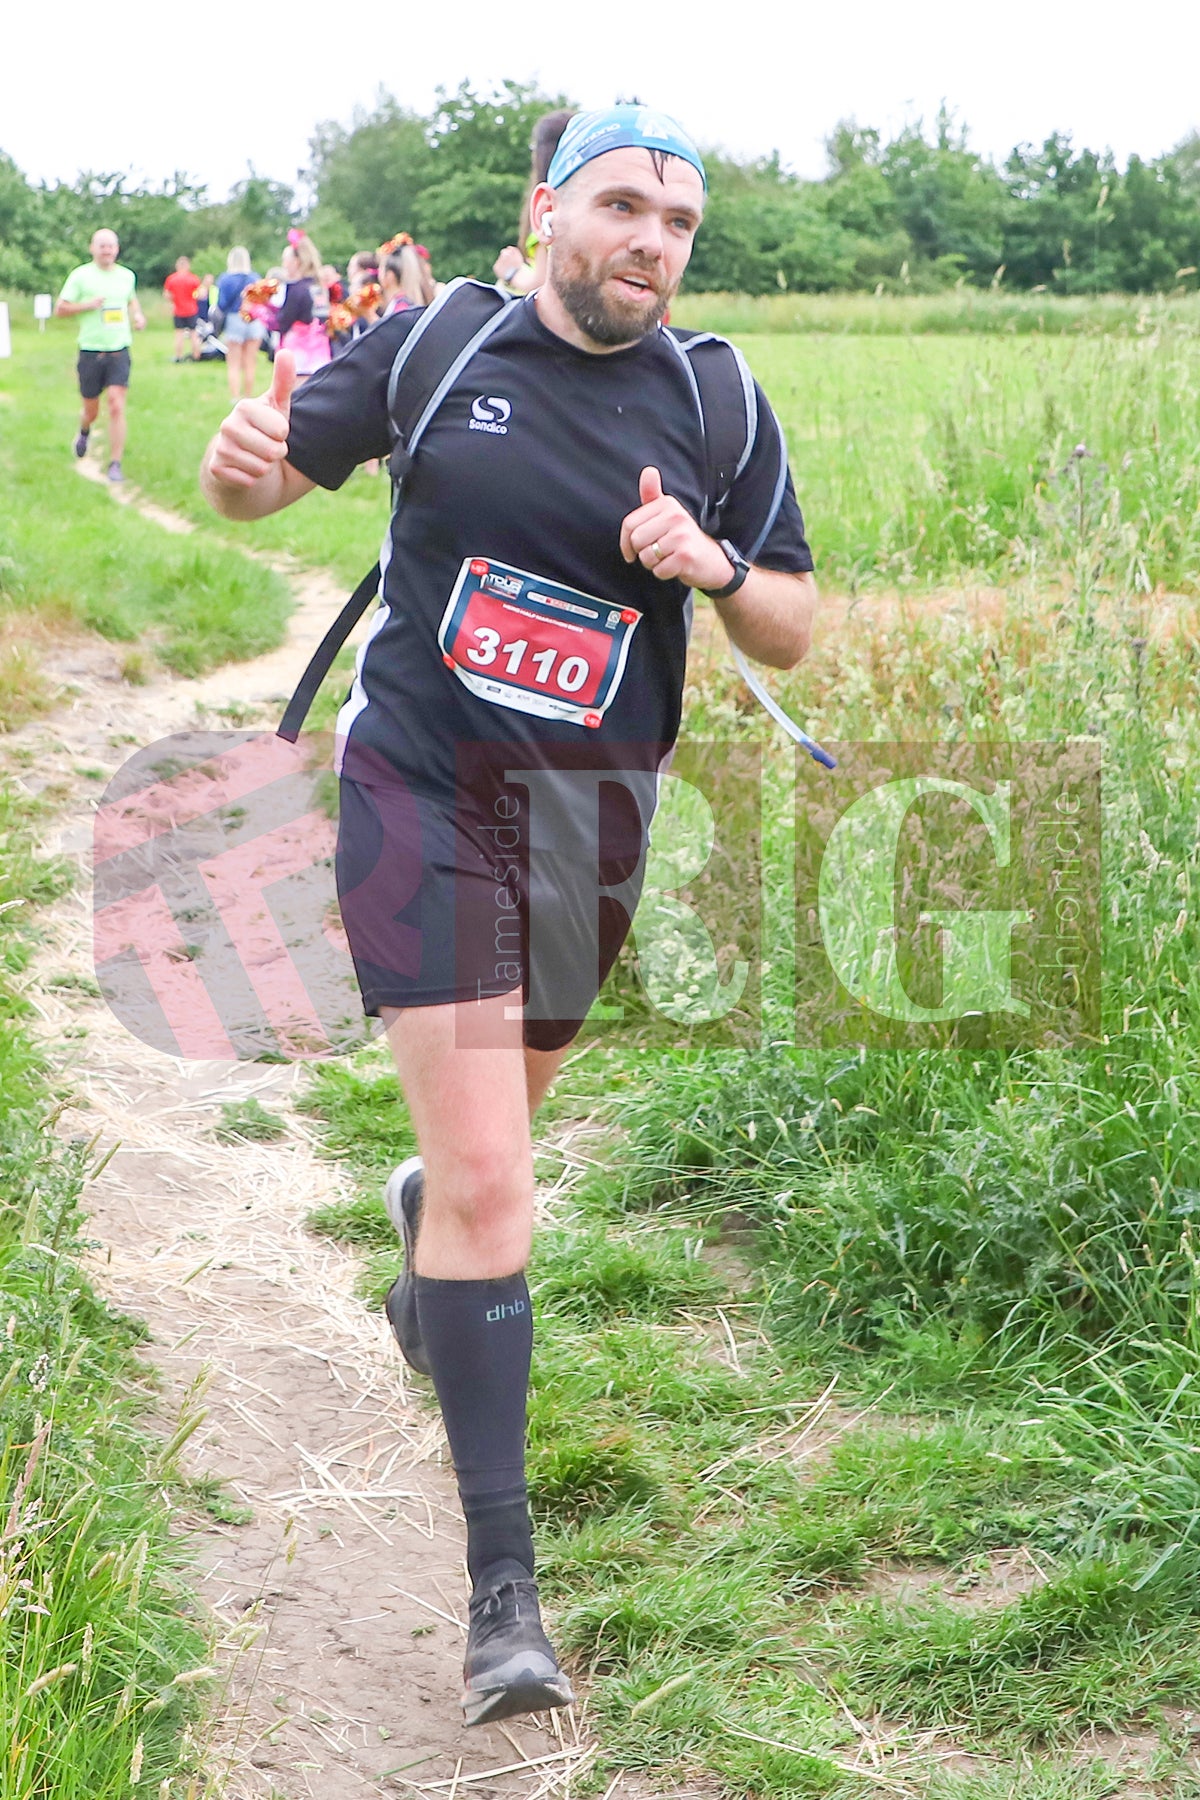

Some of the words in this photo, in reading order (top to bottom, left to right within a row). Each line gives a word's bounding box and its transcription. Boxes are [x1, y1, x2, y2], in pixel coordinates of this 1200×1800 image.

[468, 418, 508, 435] Sondico
[466, 626, 590, 693] 3110
[485, 1298, 525, 1322] dhb
